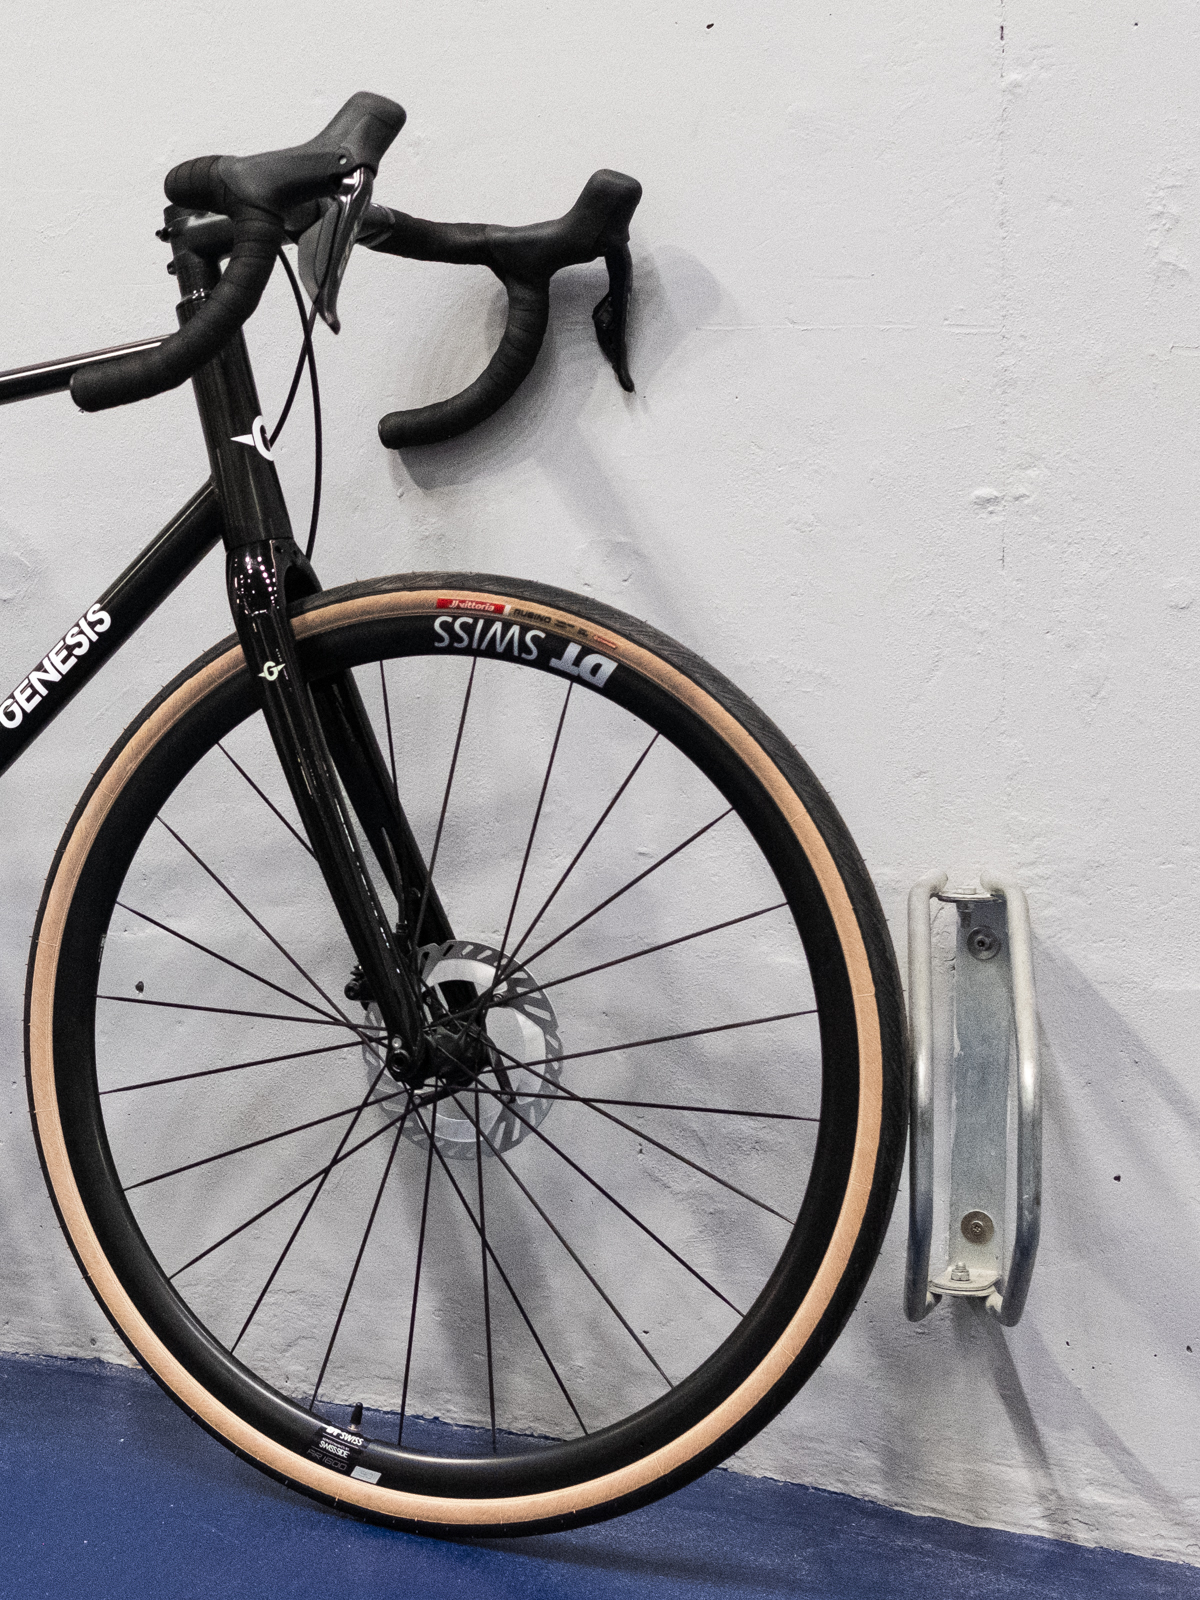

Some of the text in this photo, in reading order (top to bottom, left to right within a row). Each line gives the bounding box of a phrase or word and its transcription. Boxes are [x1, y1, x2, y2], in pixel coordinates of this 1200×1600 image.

[433, 616, 619, 688] DT SWISS
[340, 1431, 365, 1446] SWISS
